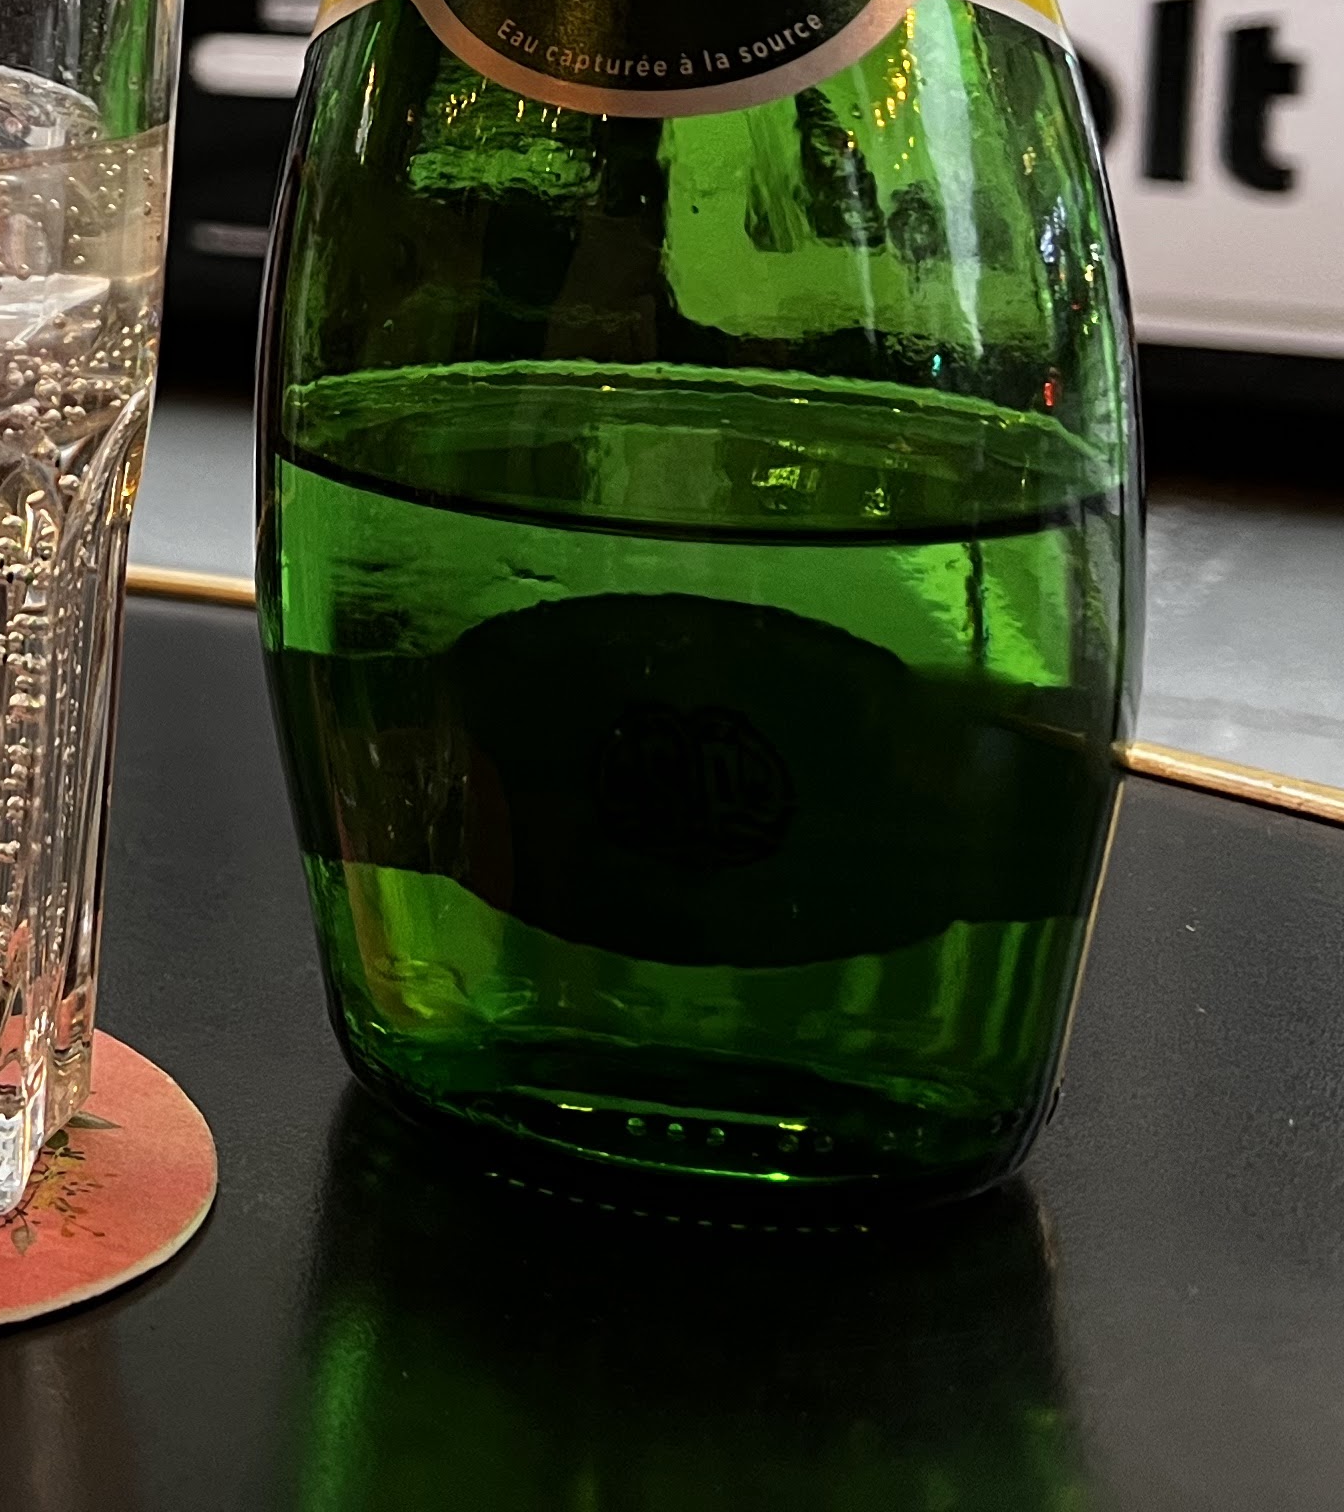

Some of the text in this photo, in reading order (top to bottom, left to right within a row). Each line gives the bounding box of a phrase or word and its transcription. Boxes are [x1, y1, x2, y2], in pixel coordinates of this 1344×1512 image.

[496, 13, 825, 77] Eau capturée à la source
